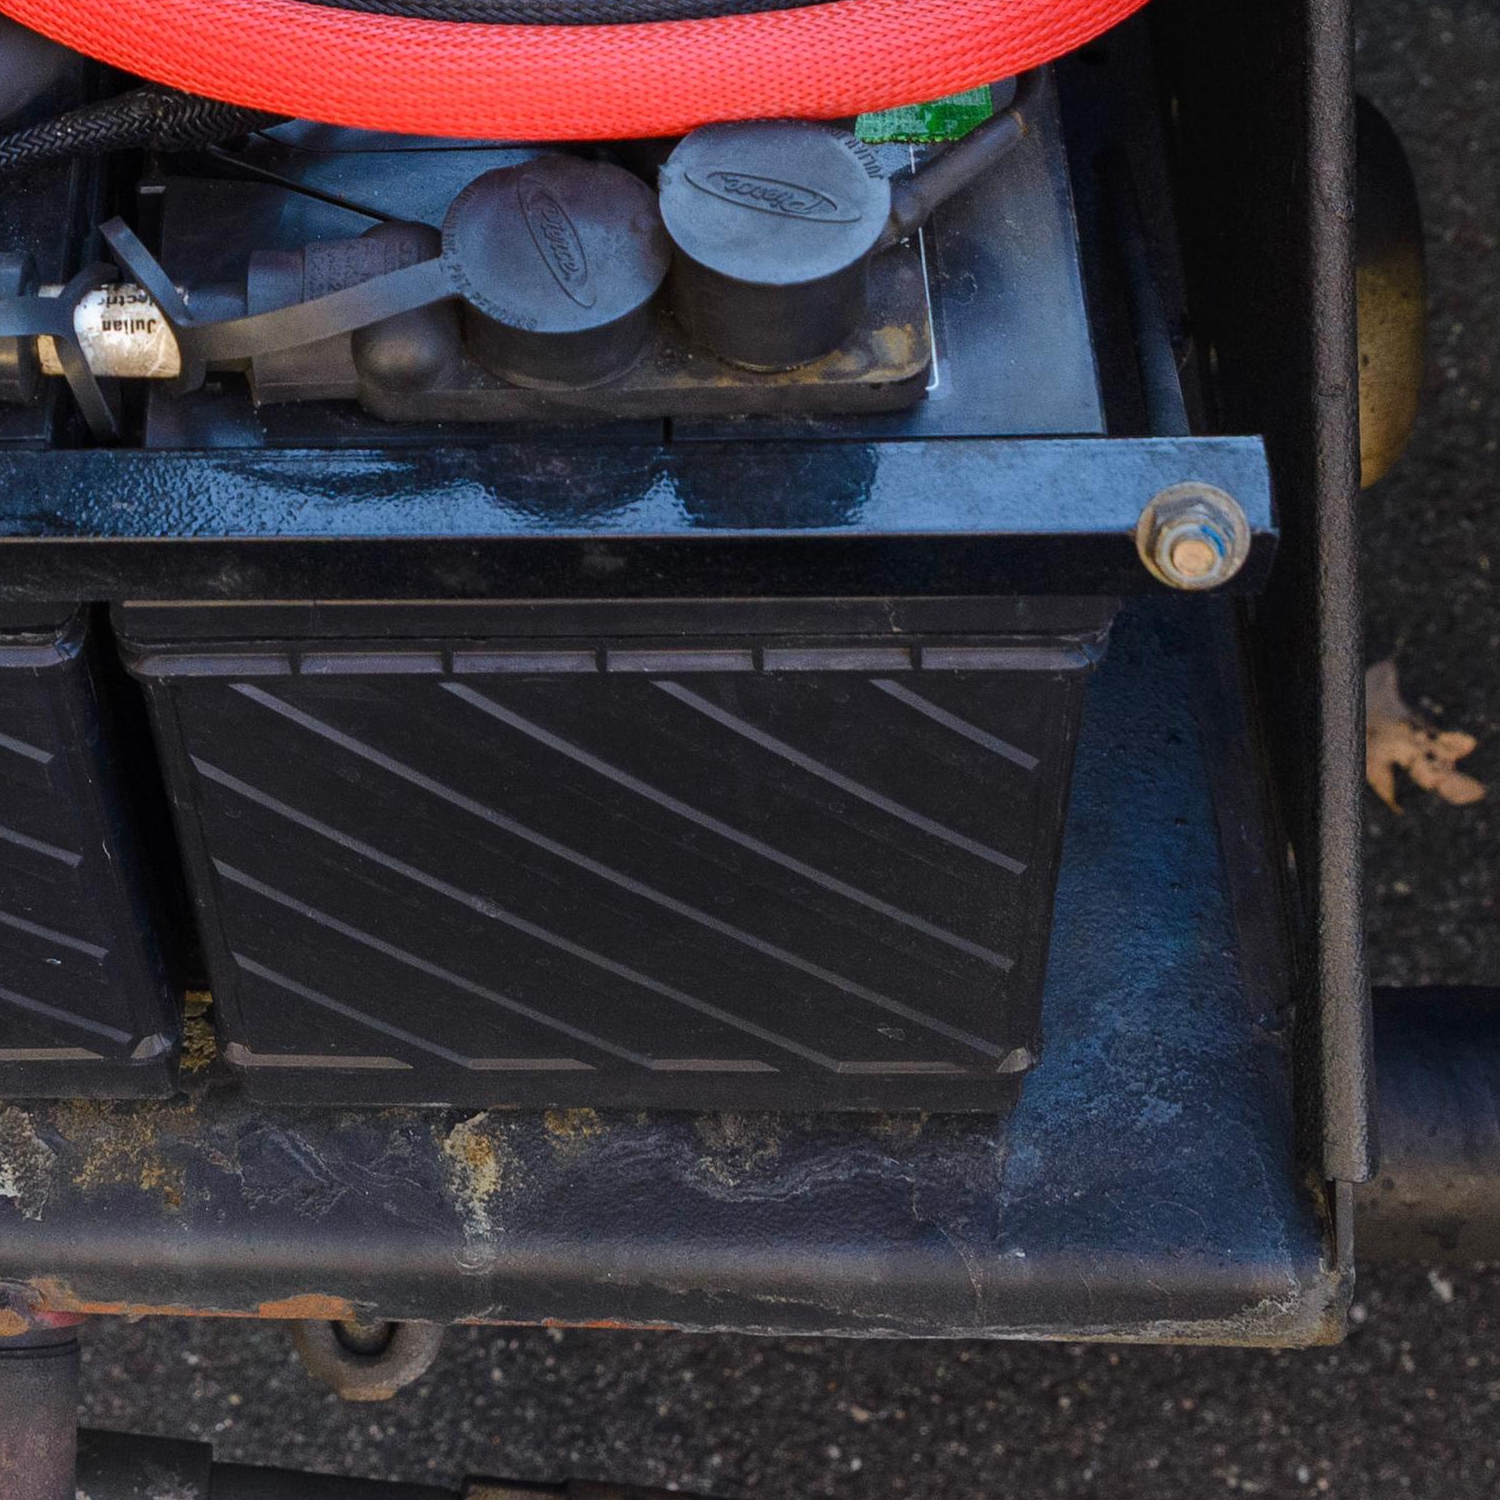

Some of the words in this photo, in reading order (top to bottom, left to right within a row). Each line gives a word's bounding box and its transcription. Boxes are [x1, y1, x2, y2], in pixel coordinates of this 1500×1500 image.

[719, 173, 824, 215] Pierce
[97, 293, 155, 309] lectric
[102, 318, 157, 335] Julian
